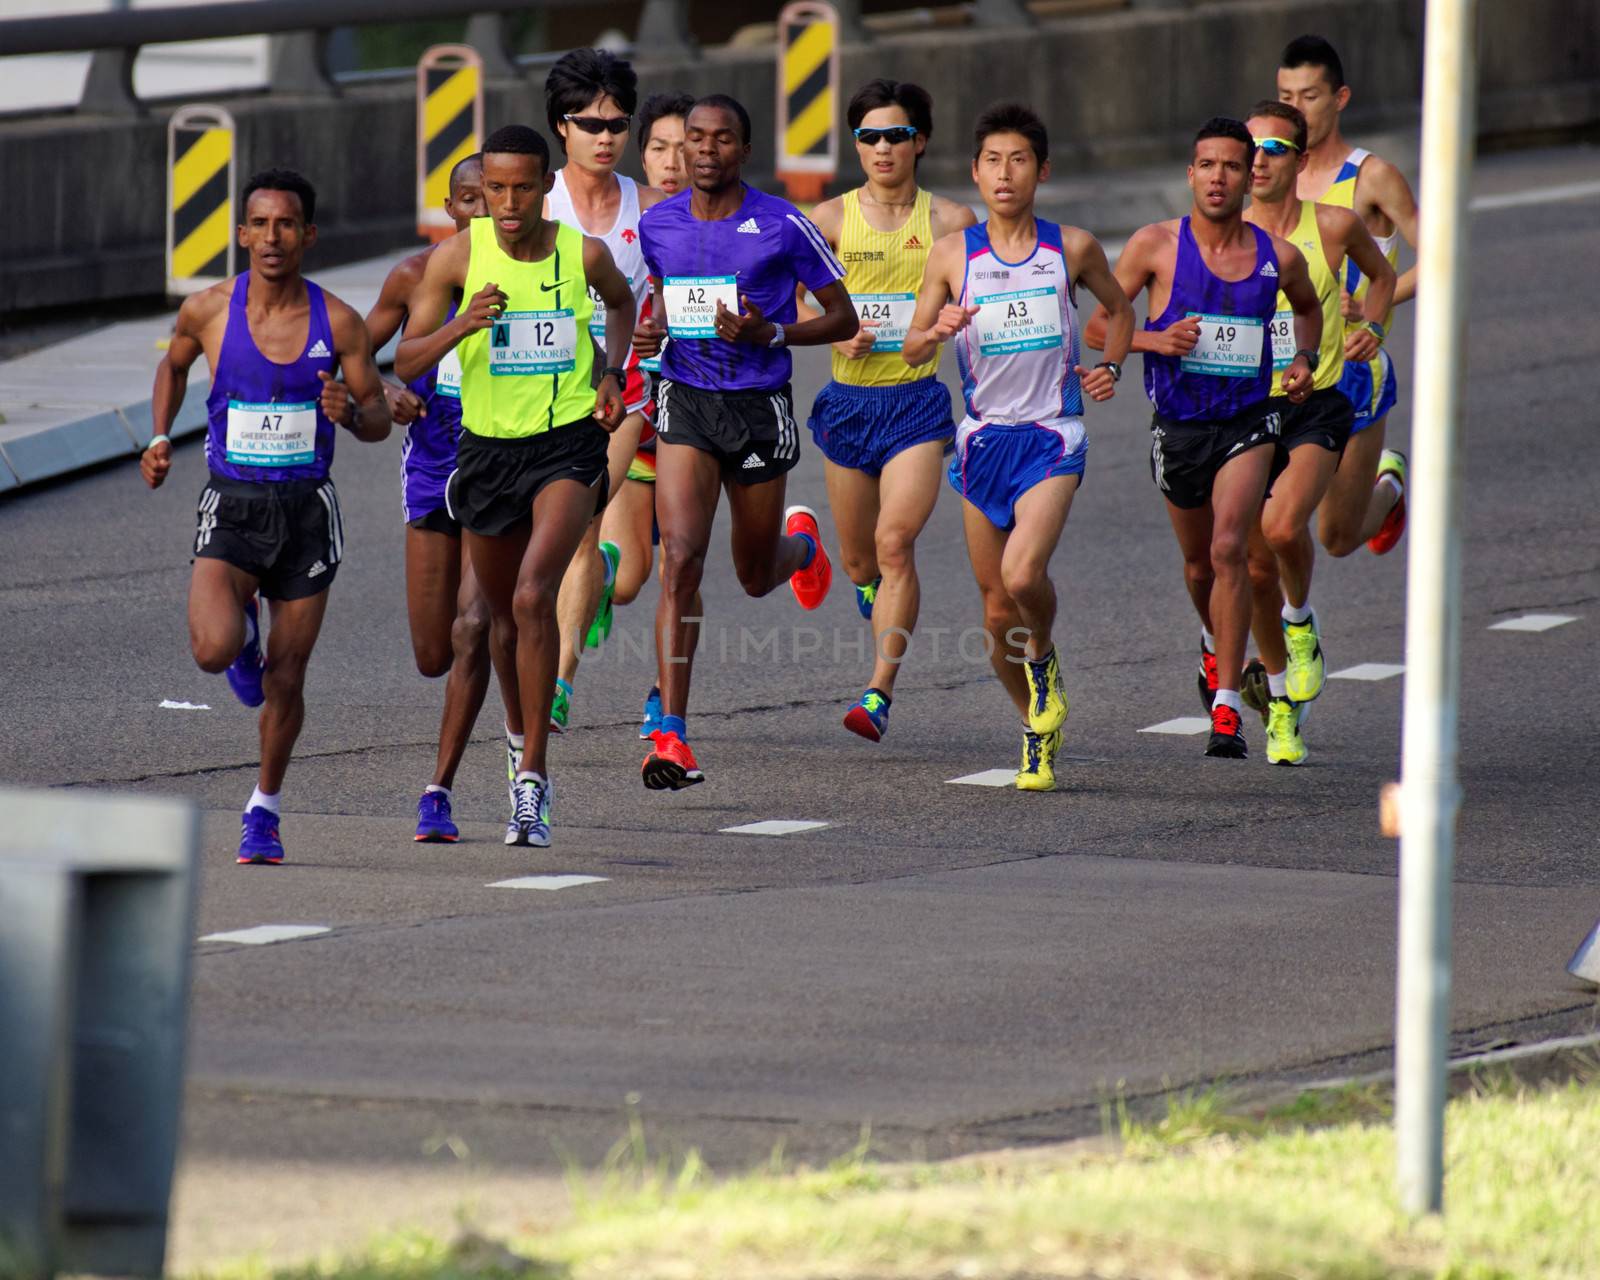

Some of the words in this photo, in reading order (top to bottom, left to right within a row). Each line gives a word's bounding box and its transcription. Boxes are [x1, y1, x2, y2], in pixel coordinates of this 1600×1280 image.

[687, 287, 707, 304] A2
[682, 305, 714, 314] NYASANGO
[860, 303, 891, 319] A24
[1007, 301, 1028, 319] A3
[671, 313, 717, 324] BLACKMO
[1003, 318, 1035, 329] KITAJIMA
[495, 324, 508, 347] A
[534, 321, 555, 346] 12
[983, 324, 1056, 342] BLACKMORES
[1215, 326, 1236, 342] A9
[1269, 321, 1289, 337] A8
[495, 348, 571, 361] BLACKMORES
[1217, 343, 1232, 351] AZIZ
[1186, 349, 1257, 363] BLACKMORES
[261, 415, 283, 431] A7
[232, 439, 308, 451] BLACKMORES
[742, 461, 765, 469] adidas
